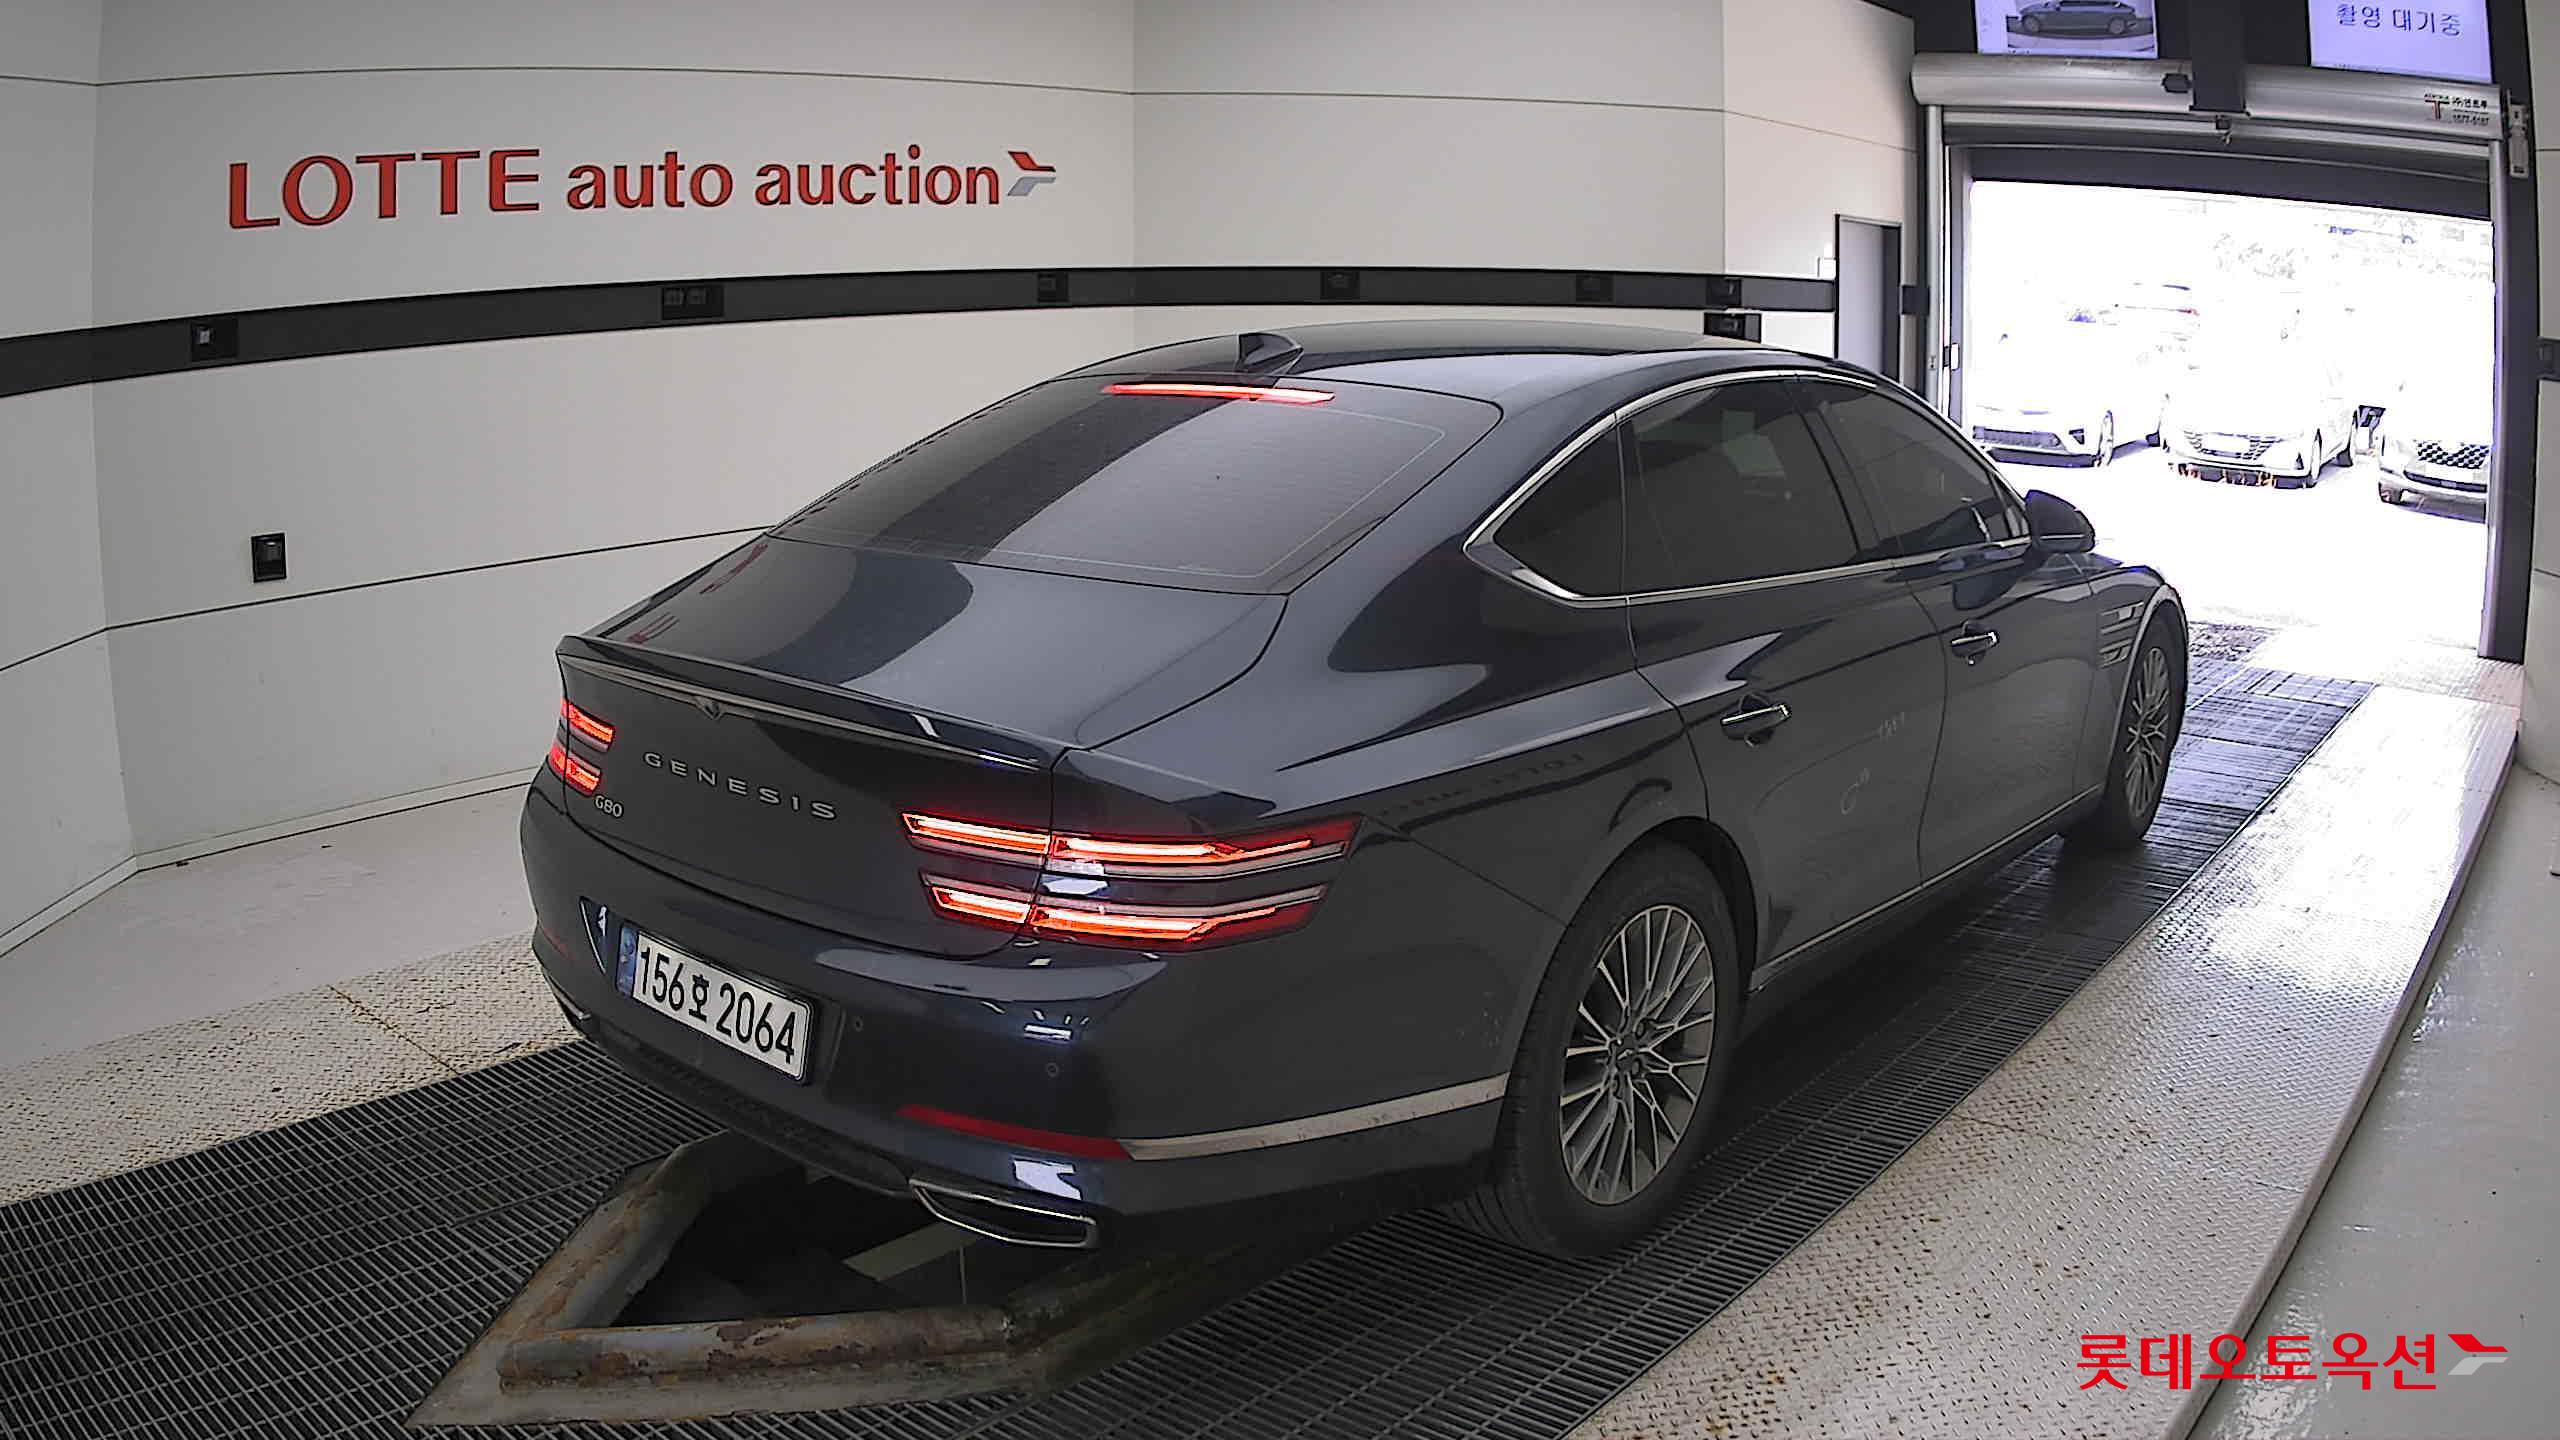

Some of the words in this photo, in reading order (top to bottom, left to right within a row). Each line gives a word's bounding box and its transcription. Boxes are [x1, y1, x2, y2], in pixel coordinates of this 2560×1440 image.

[2337, 4, 2381, 29] 촬영
[2392, 9, 2461, 36] 대기중
[229, 149, 539, 230] LOTTE
[567, 152, 733, 210] auto
[754, 145, 1000, 206] auction
[595, 796, 623, 818] G80
[642, 751, 837, 820] GENESIS
[640, 945, 710, 1022] 156호
[715, 982, 797, 1064] 2064
